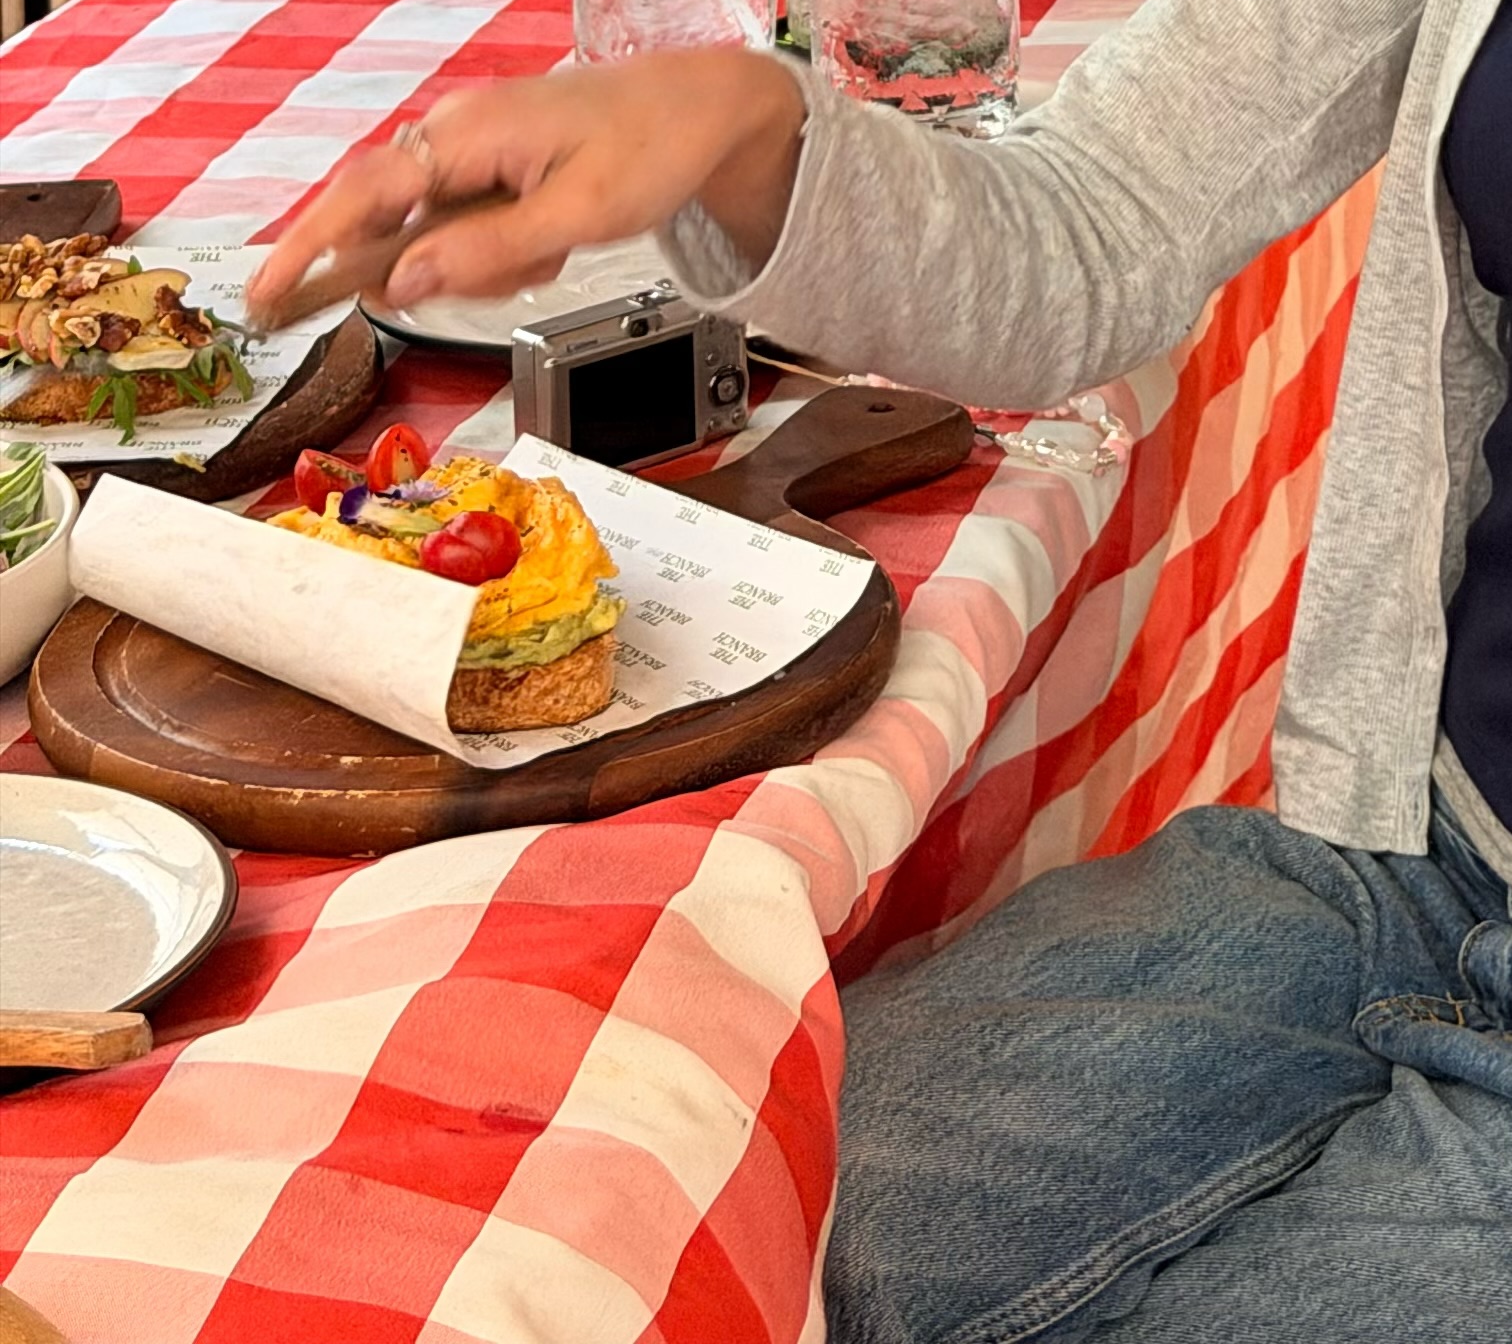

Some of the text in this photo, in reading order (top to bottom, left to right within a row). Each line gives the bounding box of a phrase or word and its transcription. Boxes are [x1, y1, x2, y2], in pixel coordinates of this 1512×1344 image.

[676, 506, 701, 525] THE
[819, 558, 844, 577] THE
[728, 594, 757, 610] THE
[731, 580, 784, 606] BRANCH
[640, 599, 693, 626] BRANCH
[709, 646, 739, 666] THE
[712, 631, 768, 663] BRANCH
